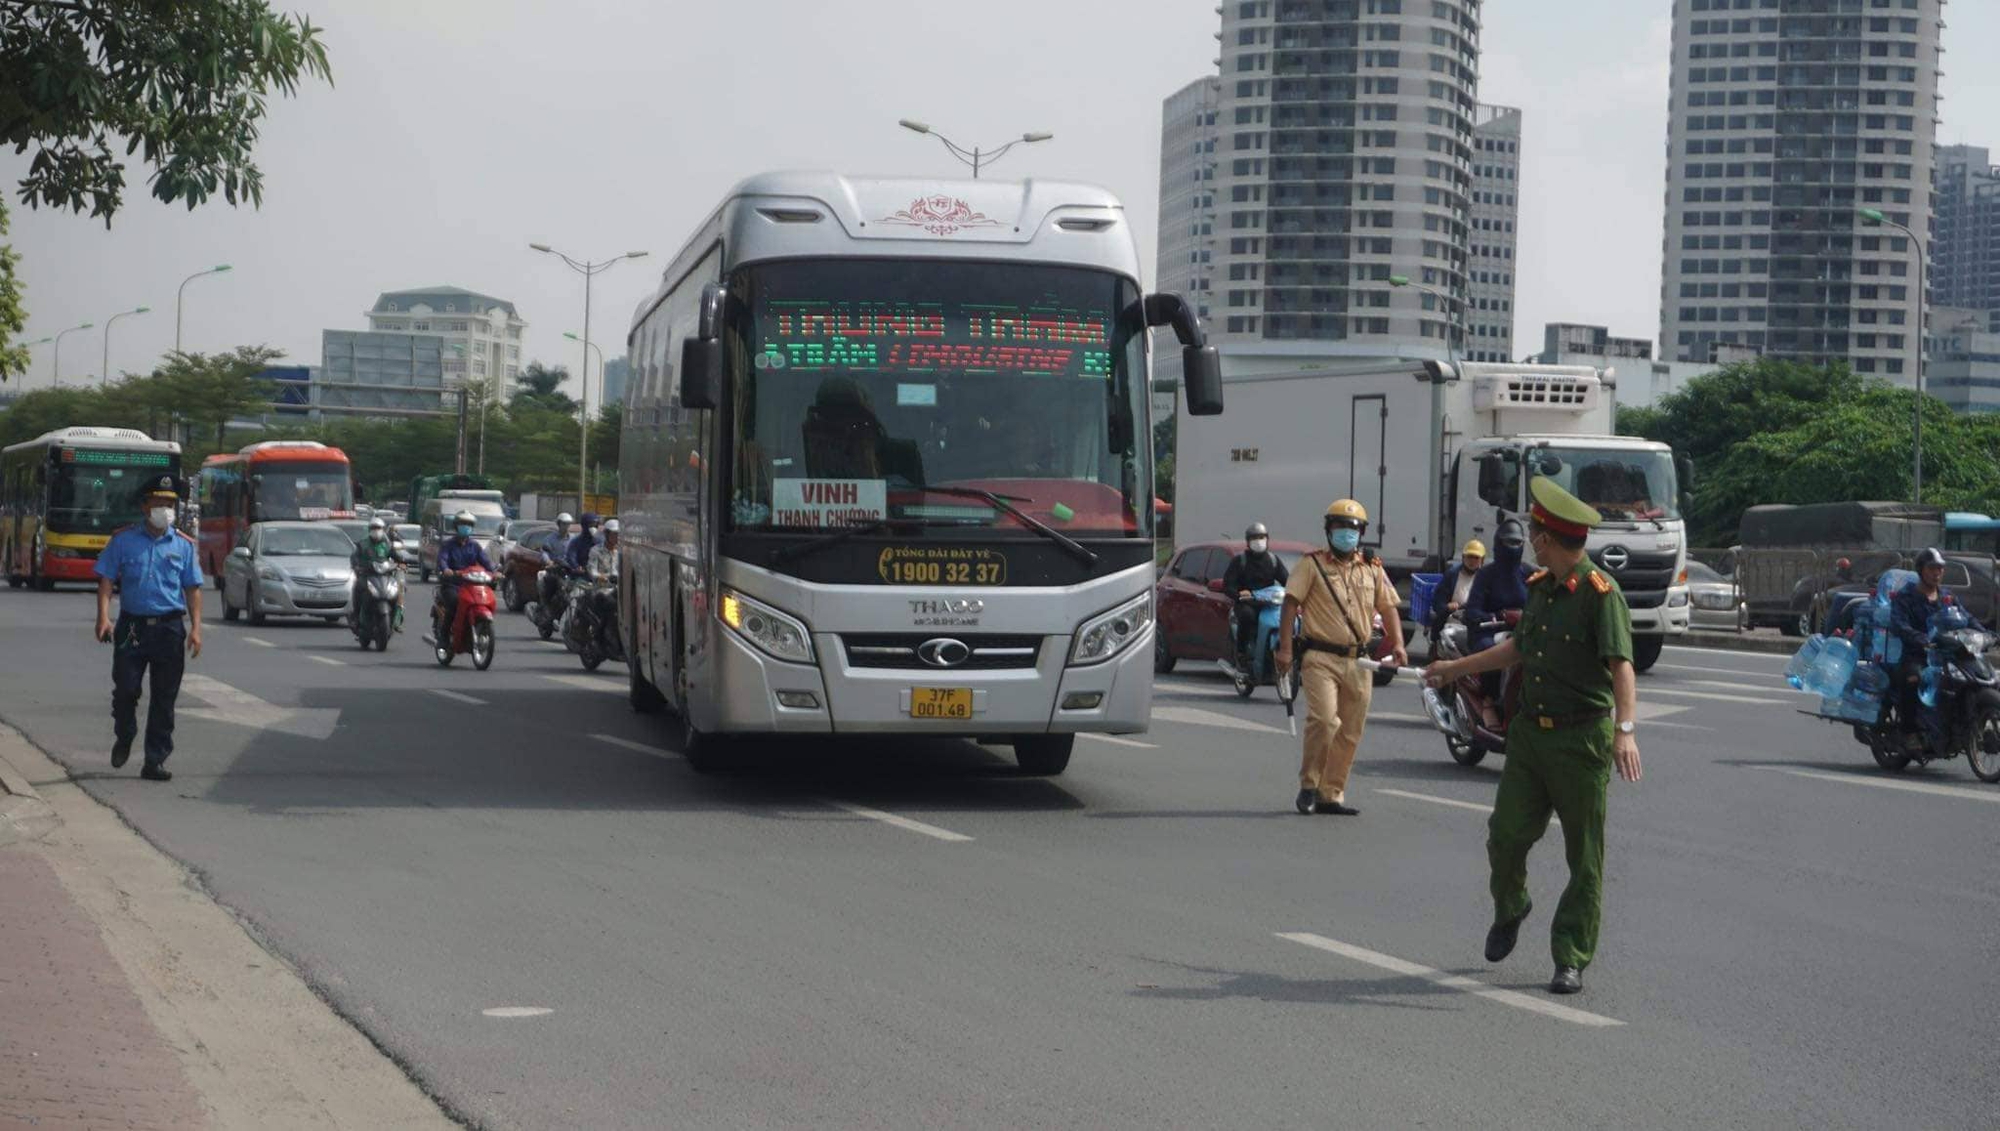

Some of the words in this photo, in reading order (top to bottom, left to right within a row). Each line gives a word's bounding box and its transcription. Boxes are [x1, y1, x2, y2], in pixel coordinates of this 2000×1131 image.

[801, 482, 858, 504] VINH
[777, 508, 821, 527] THANH
[892, 562, 940, 582] 1900
[946, 562, 971, 583] 32
[976, 562, 1000, 583] 37
[908, 600, 984, 614] THACO
[929, 687, 955, 702] 37F
[918, 702, 966, 716] 001.48
